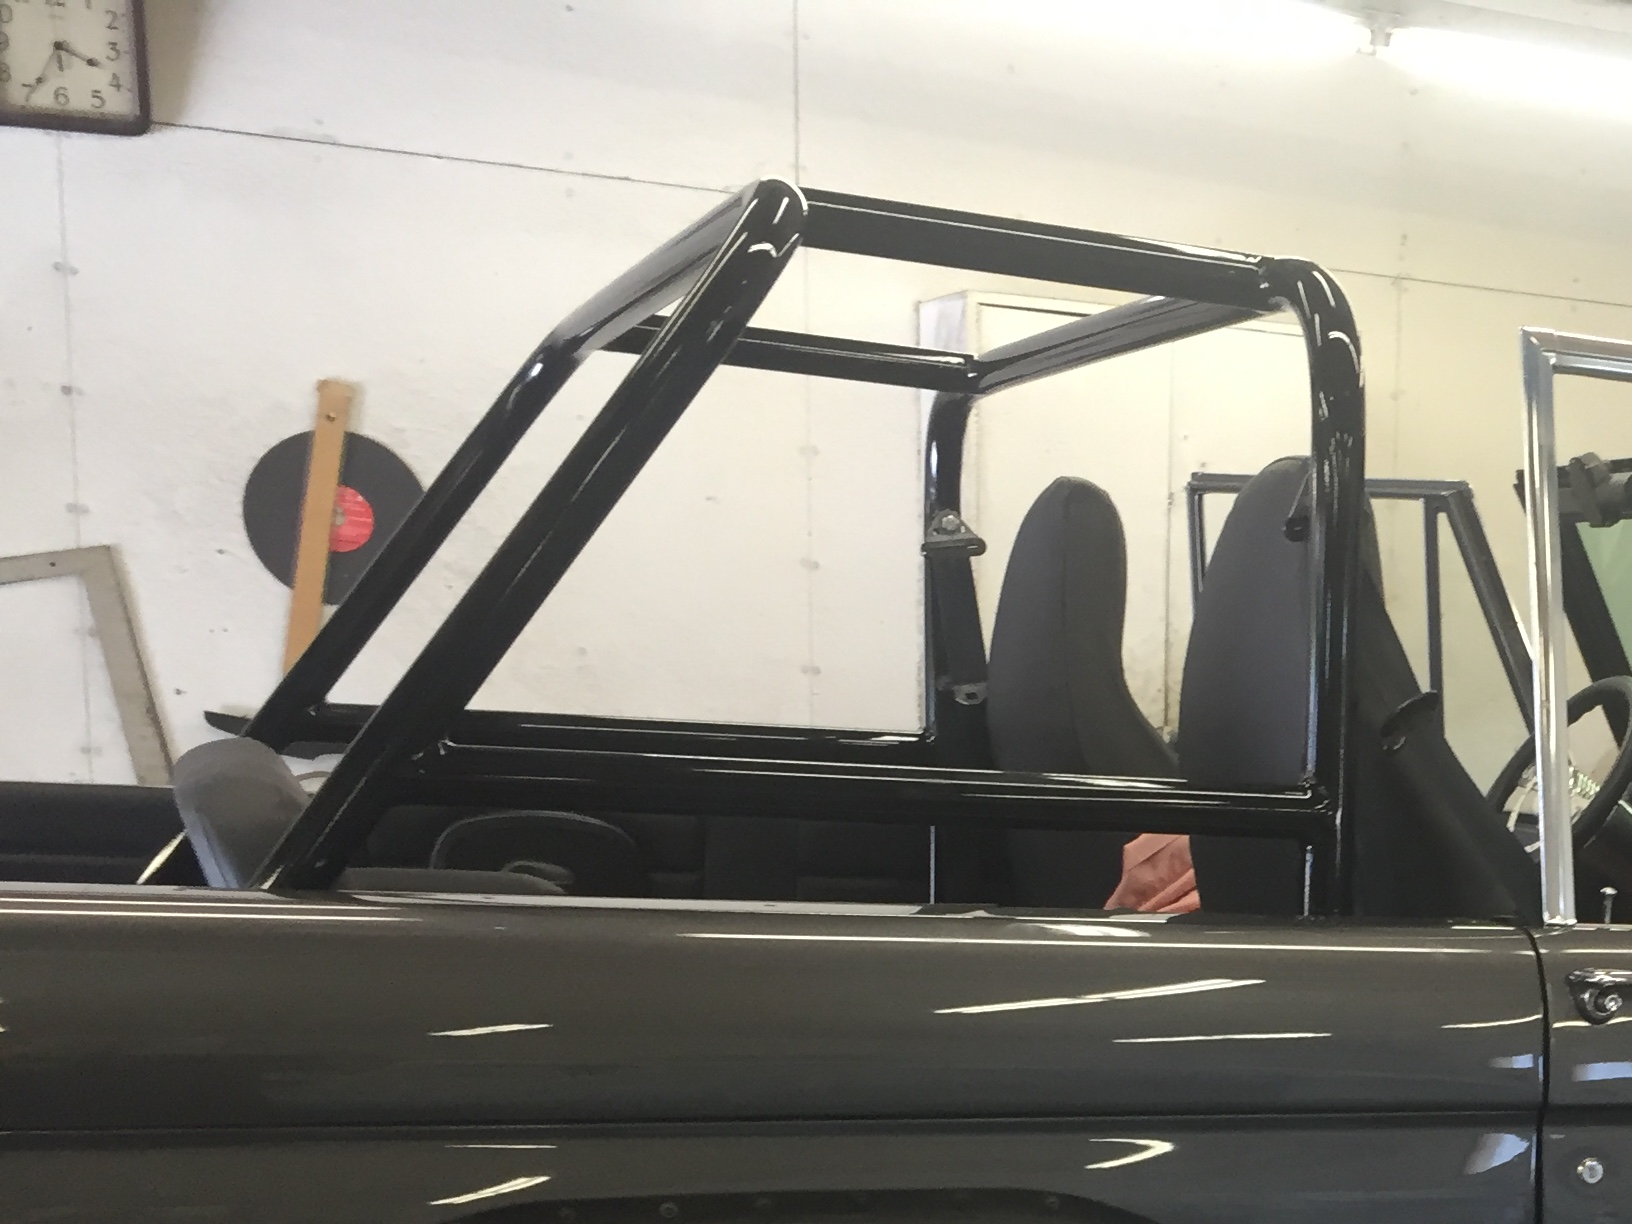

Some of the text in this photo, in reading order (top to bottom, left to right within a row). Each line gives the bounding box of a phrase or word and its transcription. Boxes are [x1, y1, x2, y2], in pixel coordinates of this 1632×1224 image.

[0, 3, 13, 23] 0
[105, 9, 119, 30] 2
[105, 41, 121, 61] 3
[109, 72, 122, 92] 4
[21, 83, 38, 102] 7
[53, 86, 70, 106] 6
[91, 90, 107, 108] 5
